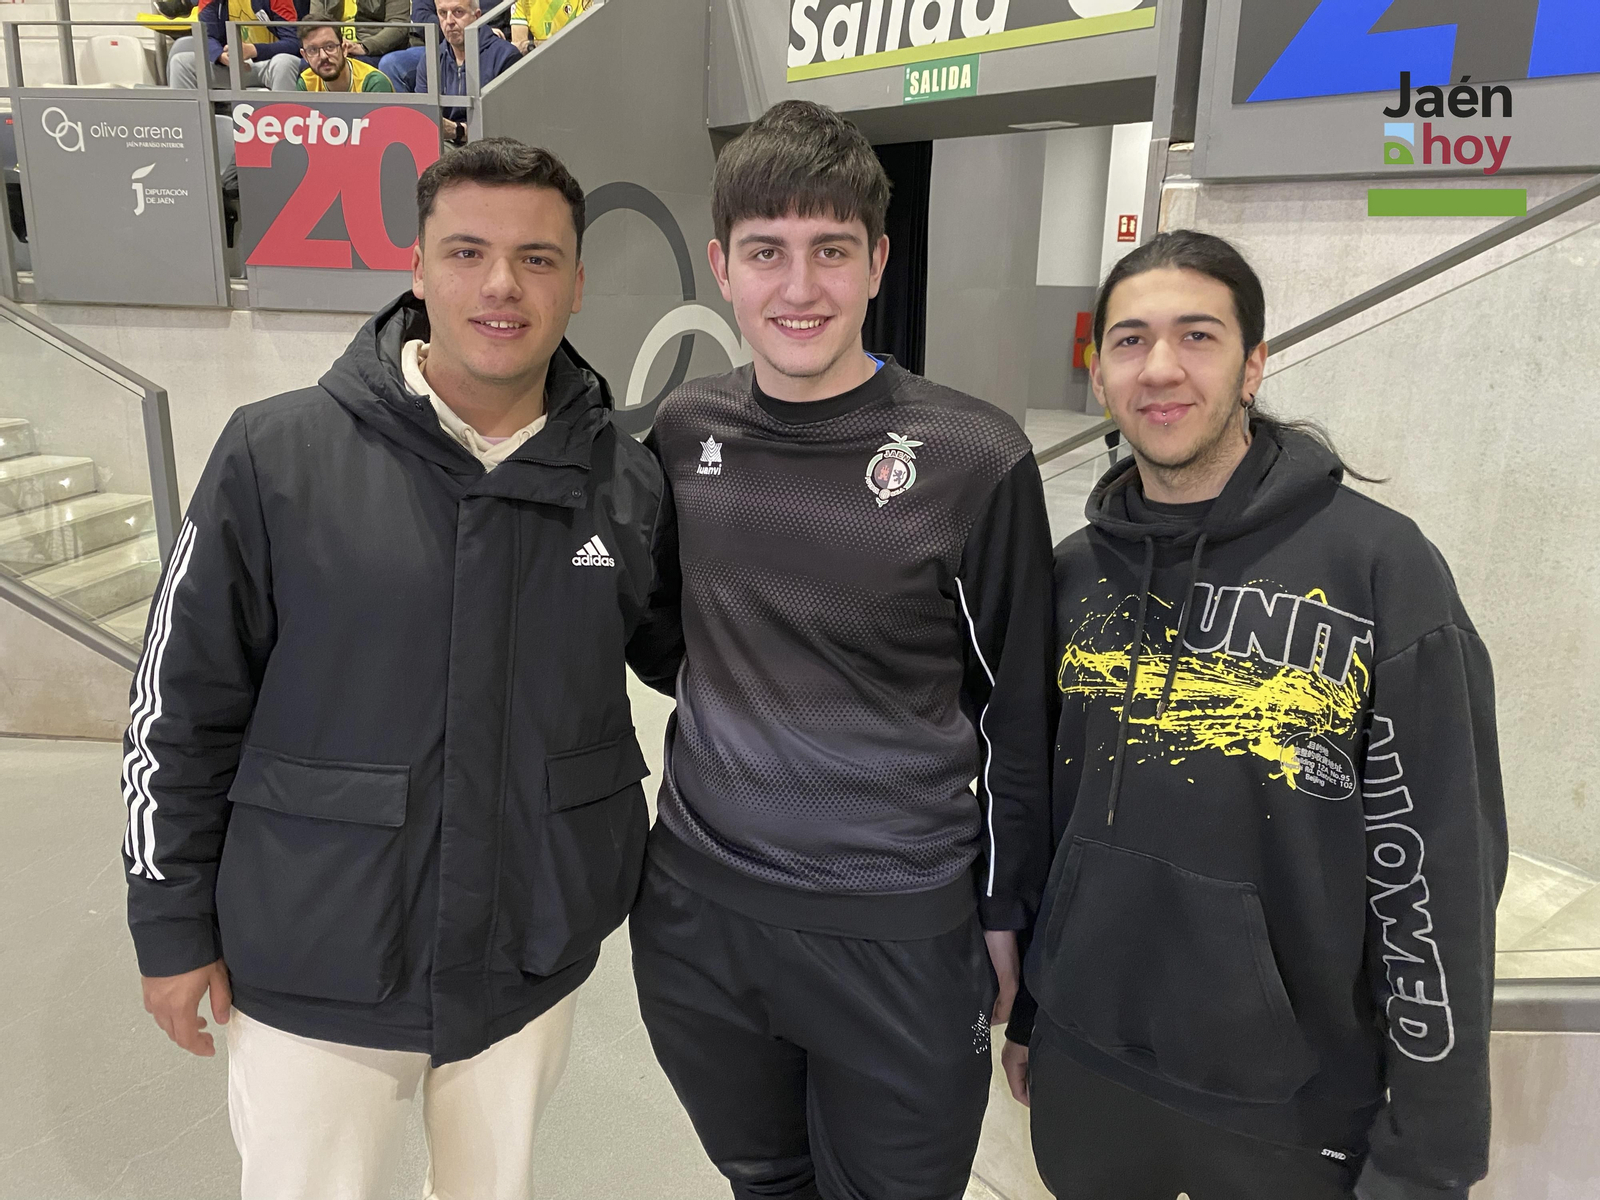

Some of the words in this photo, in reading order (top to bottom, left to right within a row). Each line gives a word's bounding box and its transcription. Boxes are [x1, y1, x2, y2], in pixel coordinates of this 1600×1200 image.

[787, 0, 1009, 68] Salida
[909, 63, 971, 95] SALIDA
[90, 121, 129, 138] olivo
[133, 125, 183, 139] arena
[232, 103, 369, 145] Sector
[145, 188, 188, 196] DIPUTACIÓN
[234, 103, 440, 271] 20
[571, 554, 615, 567] adidas
[1340, 781, 1353, 789] 102
